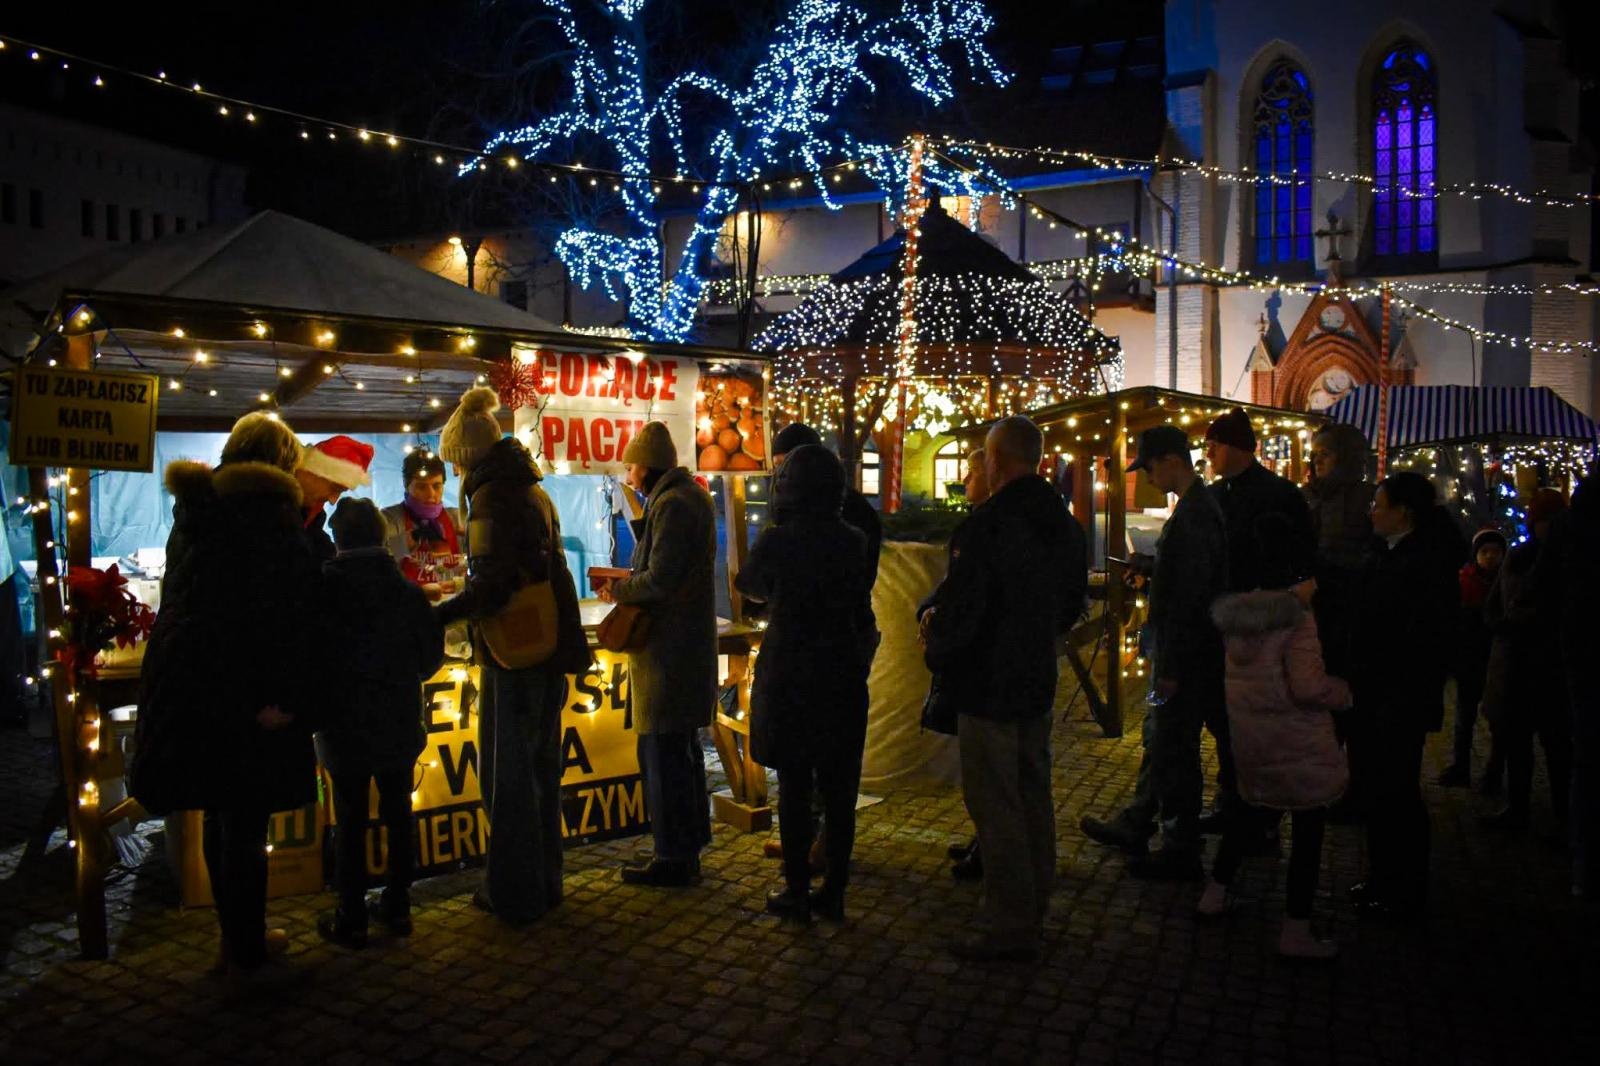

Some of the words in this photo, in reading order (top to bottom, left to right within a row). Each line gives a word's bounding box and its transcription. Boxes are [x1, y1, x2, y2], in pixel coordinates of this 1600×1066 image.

[26, 373, 48, 395] TU
[54, 376, 147, 404] ZAPŁACISZ
[537, 348, 679, 406] GORĄCE
[58, 406, 114, 436] KARTĄ
[25, 435, 61, 457] LUB
[67, 437, 139, 462] BLIKIEM
[542, 416, 644, 469] PĄCZ
